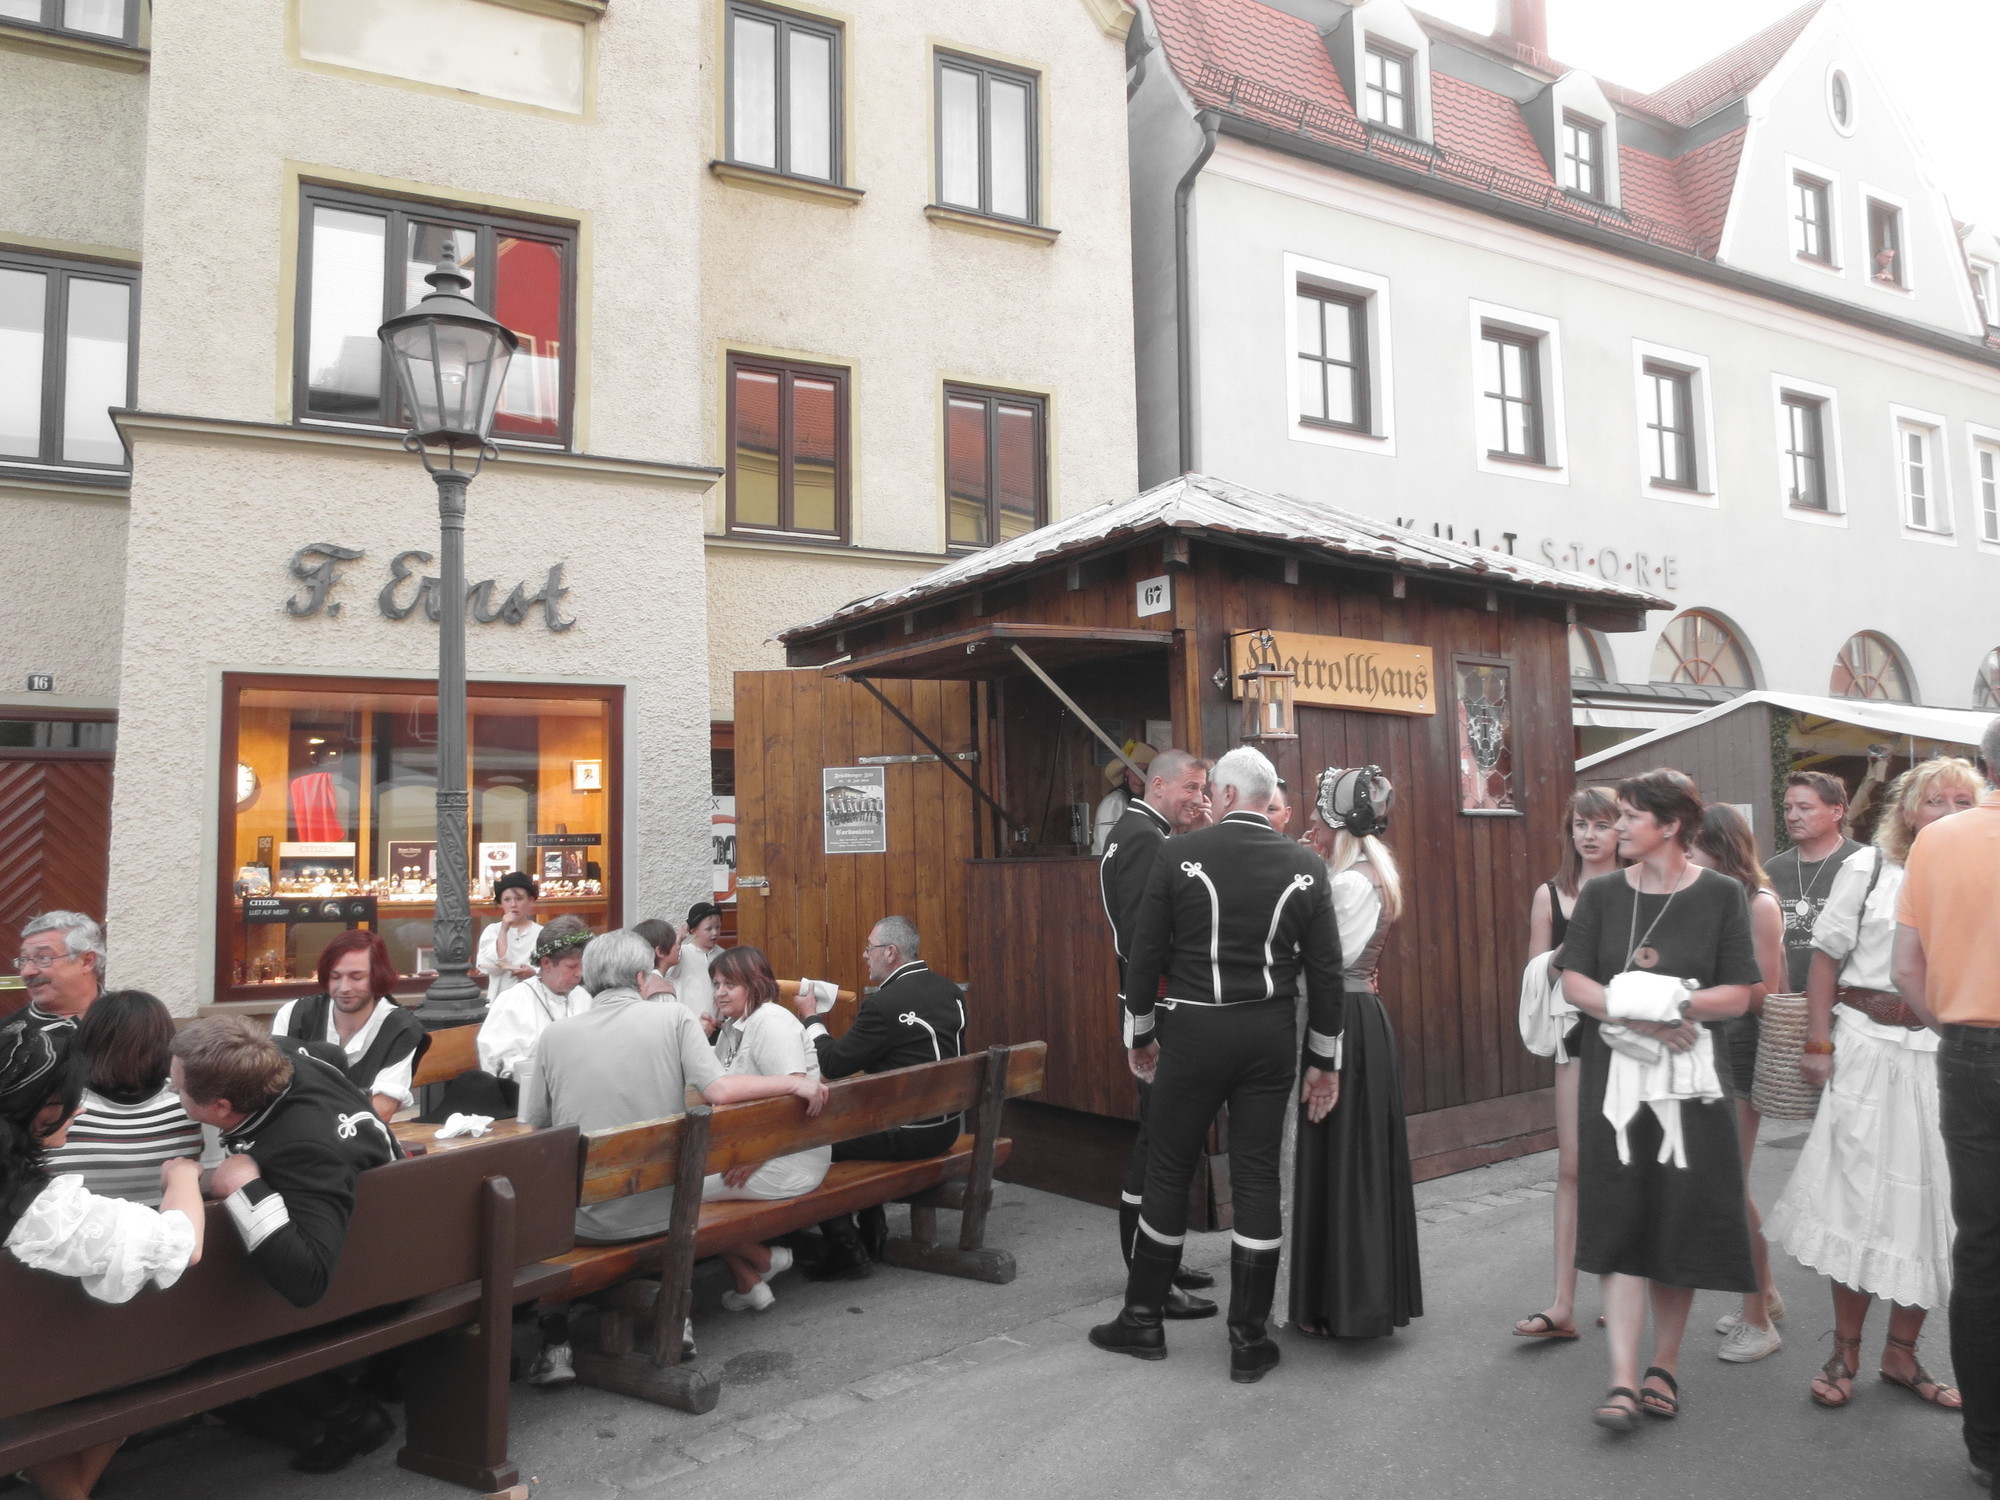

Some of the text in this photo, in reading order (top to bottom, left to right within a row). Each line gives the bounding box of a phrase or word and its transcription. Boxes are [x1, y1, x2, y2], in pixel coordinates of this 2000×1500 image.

[1144, 584, 1163, 606] 67
[32, 675, 49, 690] 16
[299, 845, 336, 853] CITIZEN
